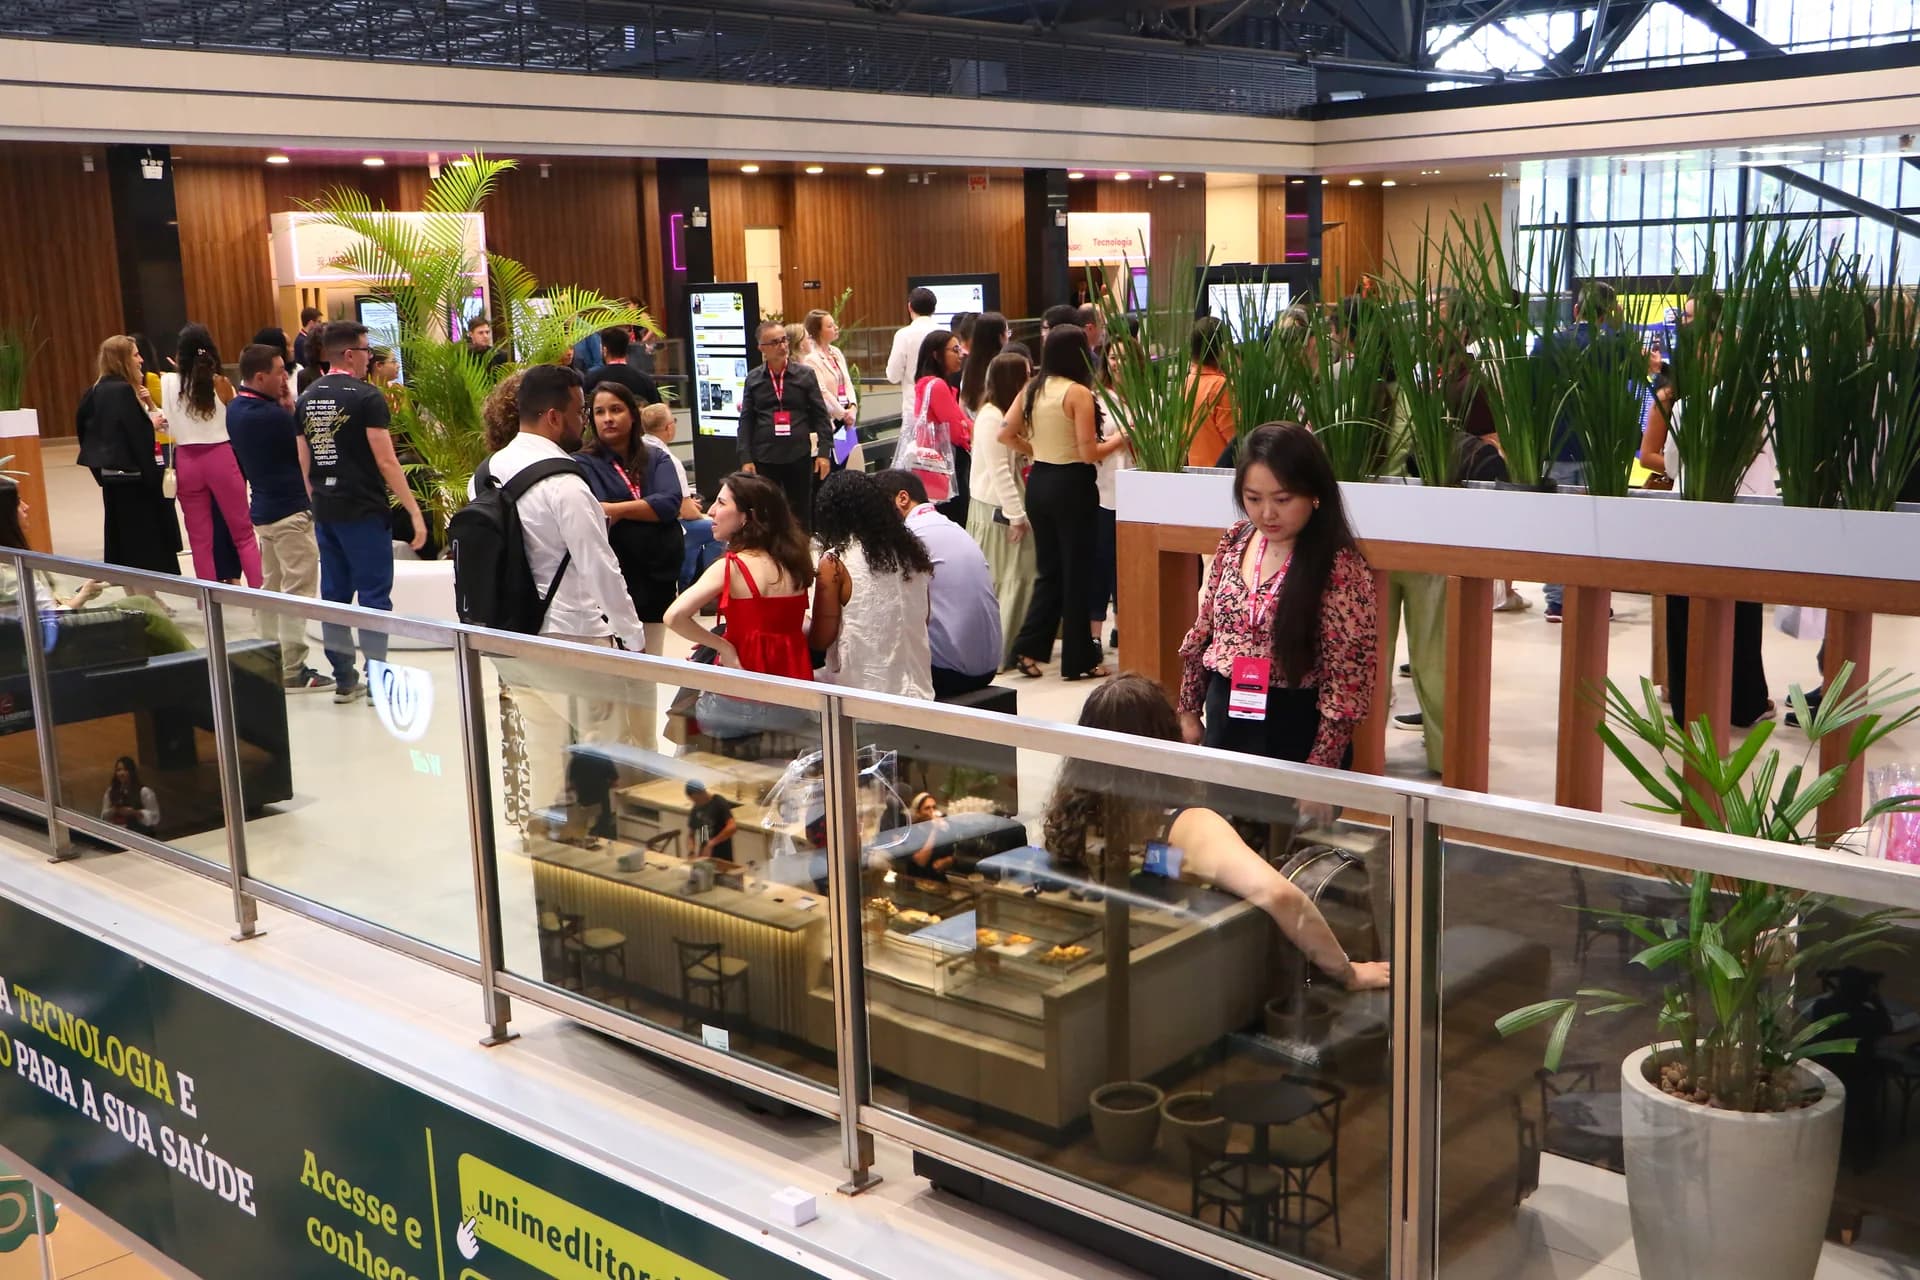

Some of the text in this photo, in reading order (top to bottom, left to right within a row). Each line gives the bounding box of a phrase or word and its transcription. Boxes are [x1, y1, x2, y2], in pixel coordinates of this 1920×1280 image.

[1093, 238, 1133, 248] Tecnologia
[13, 983, 175, 1106] TECNOLOGIA
[176, 1070, 198, 1119] E
[14, 1039, 78, 1109] PARA
[81, 1078, 101, 1122] A
[103, 1092, 157, 1156] SUA
[160, 1124, 257, 1217] SAÚDE
[300, 1148, 422, 1249] Acesse e
[478, 1189, 681, 1280] unimedlito
[306, 1216, 420, 1280] conhe
